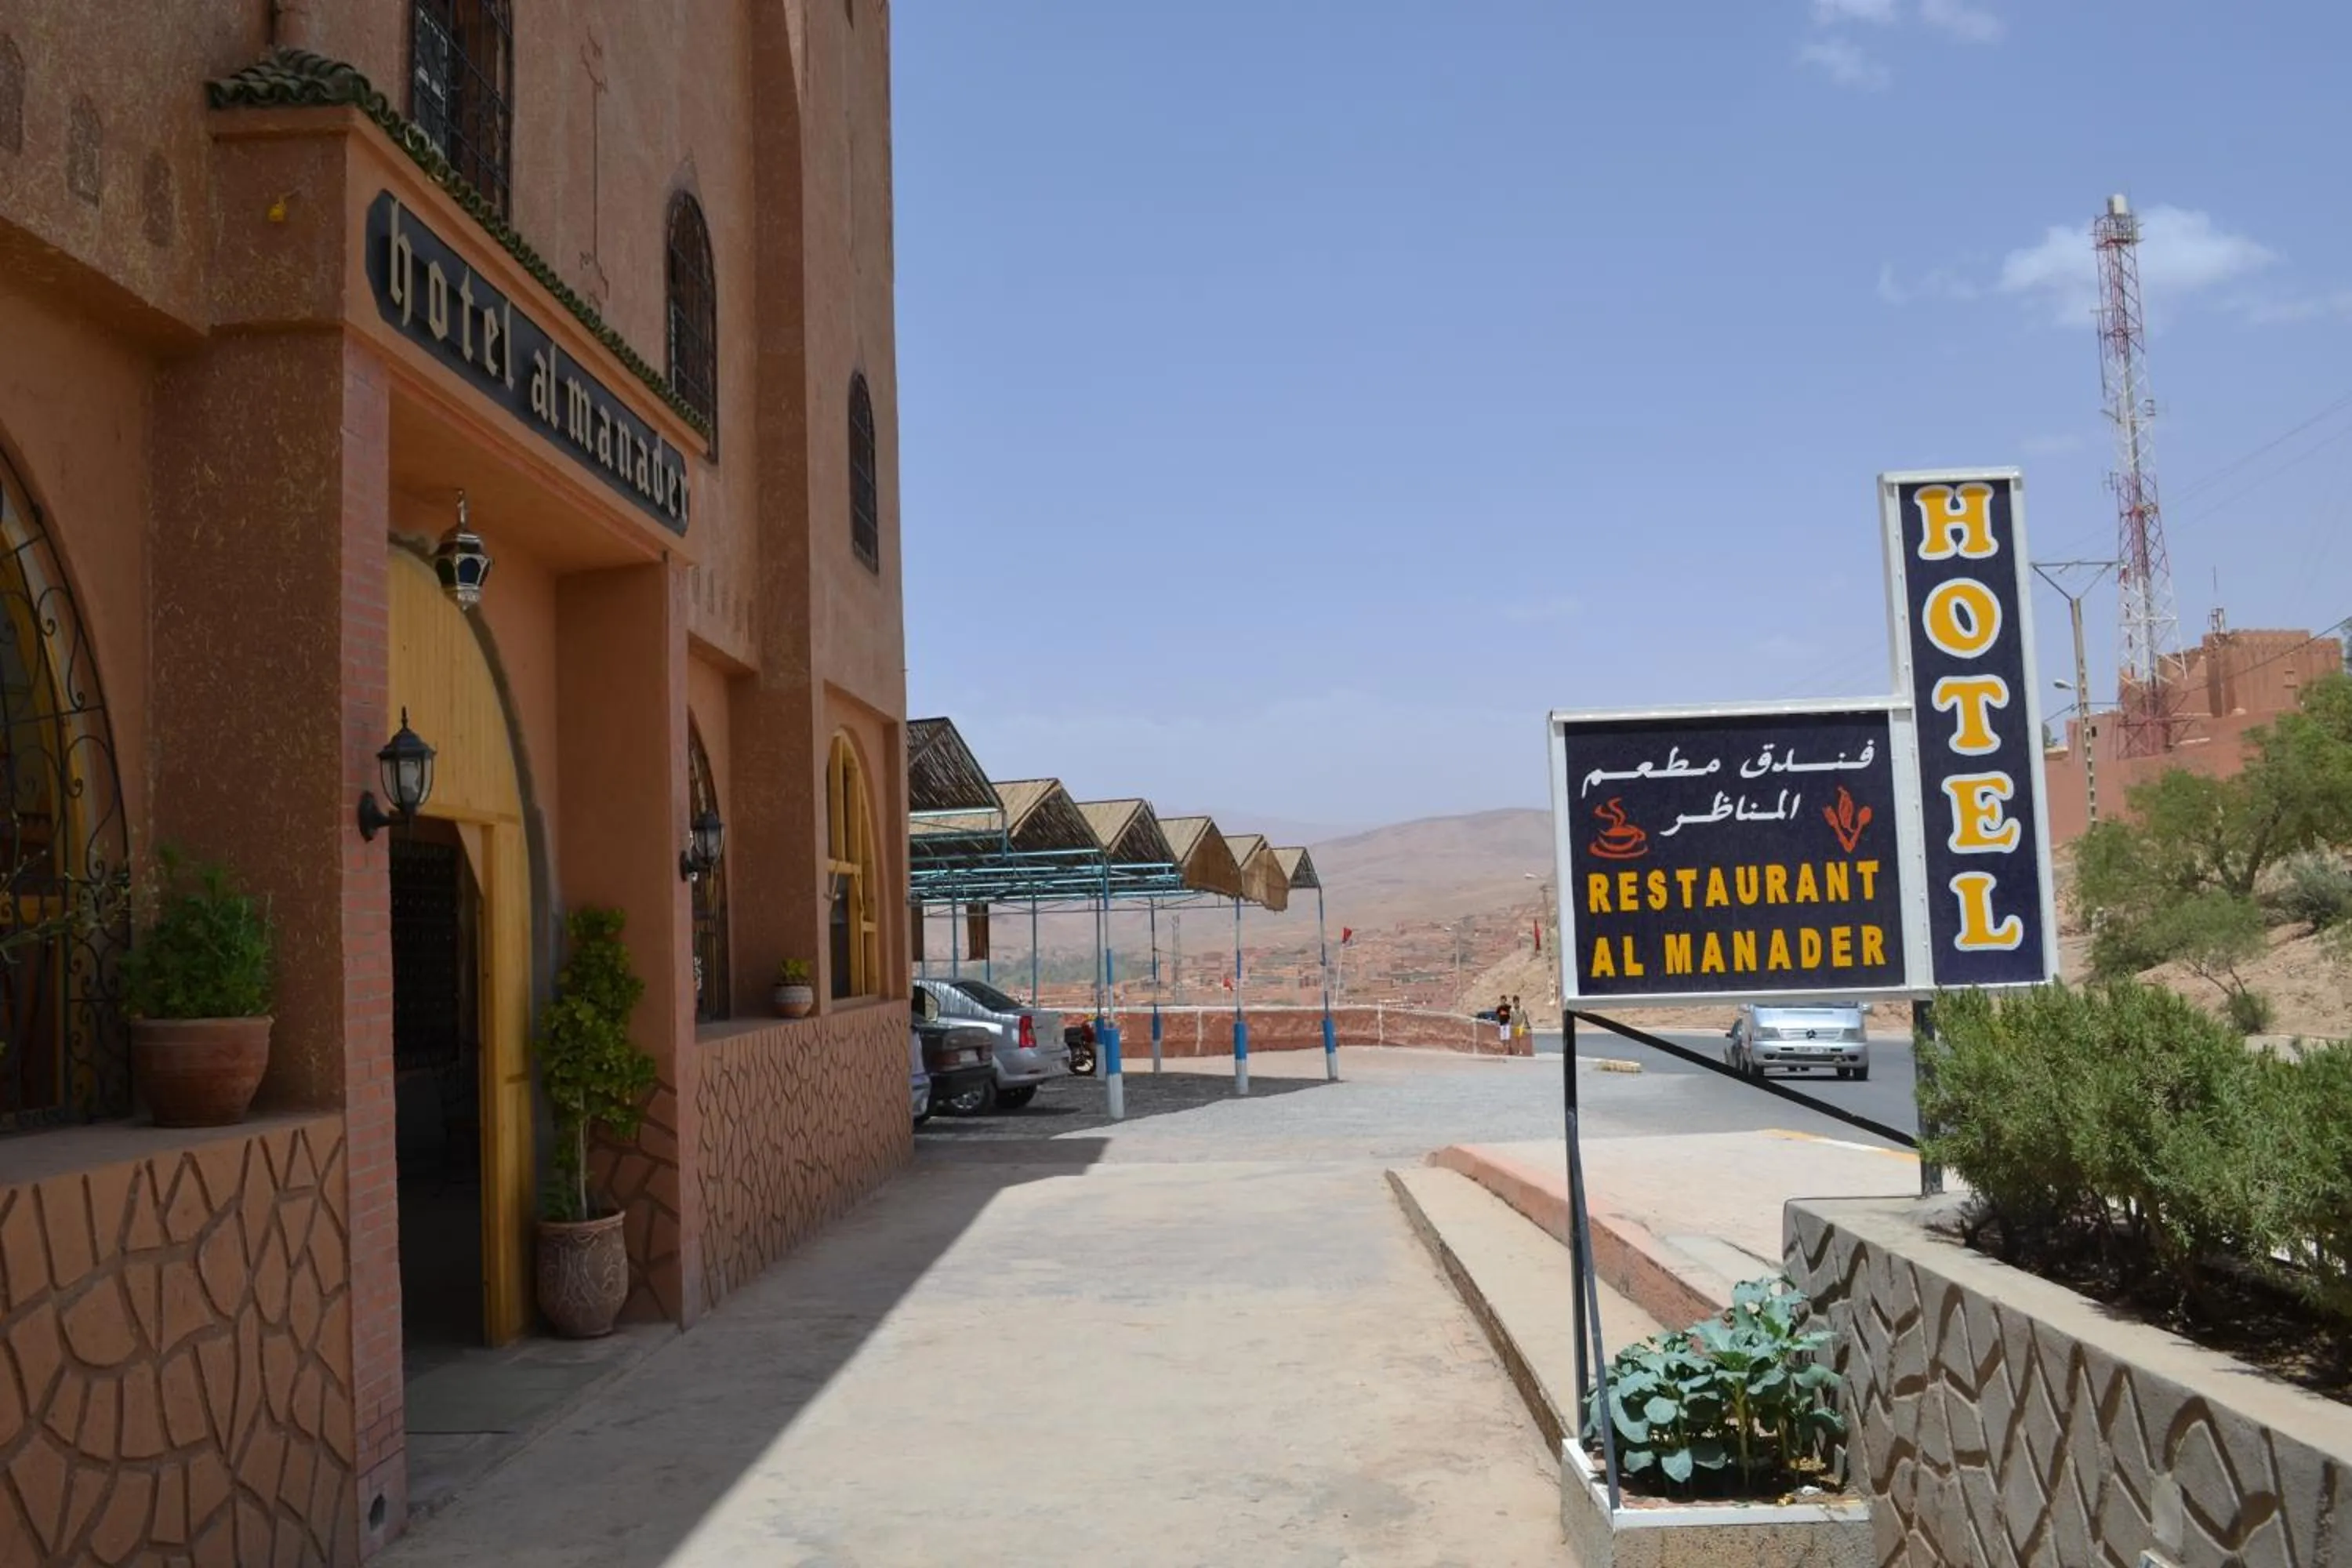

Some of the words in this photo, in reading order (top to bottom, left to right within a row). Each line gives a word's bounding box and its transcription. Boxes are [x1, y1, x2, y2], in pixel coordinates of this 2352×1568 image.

[390, 198, 514, 390] hotel
[1914, 483, 2024, 951] HOTEL
[1581, 746, 1721, 799] مطعم
[1659, 789, 1801, 837] المناظر
[1588, 860, 1879, 913] RESTAURANT
[1592, 936, 1644, 978] AL
[1664, 925, 1886, 975] MANADER
